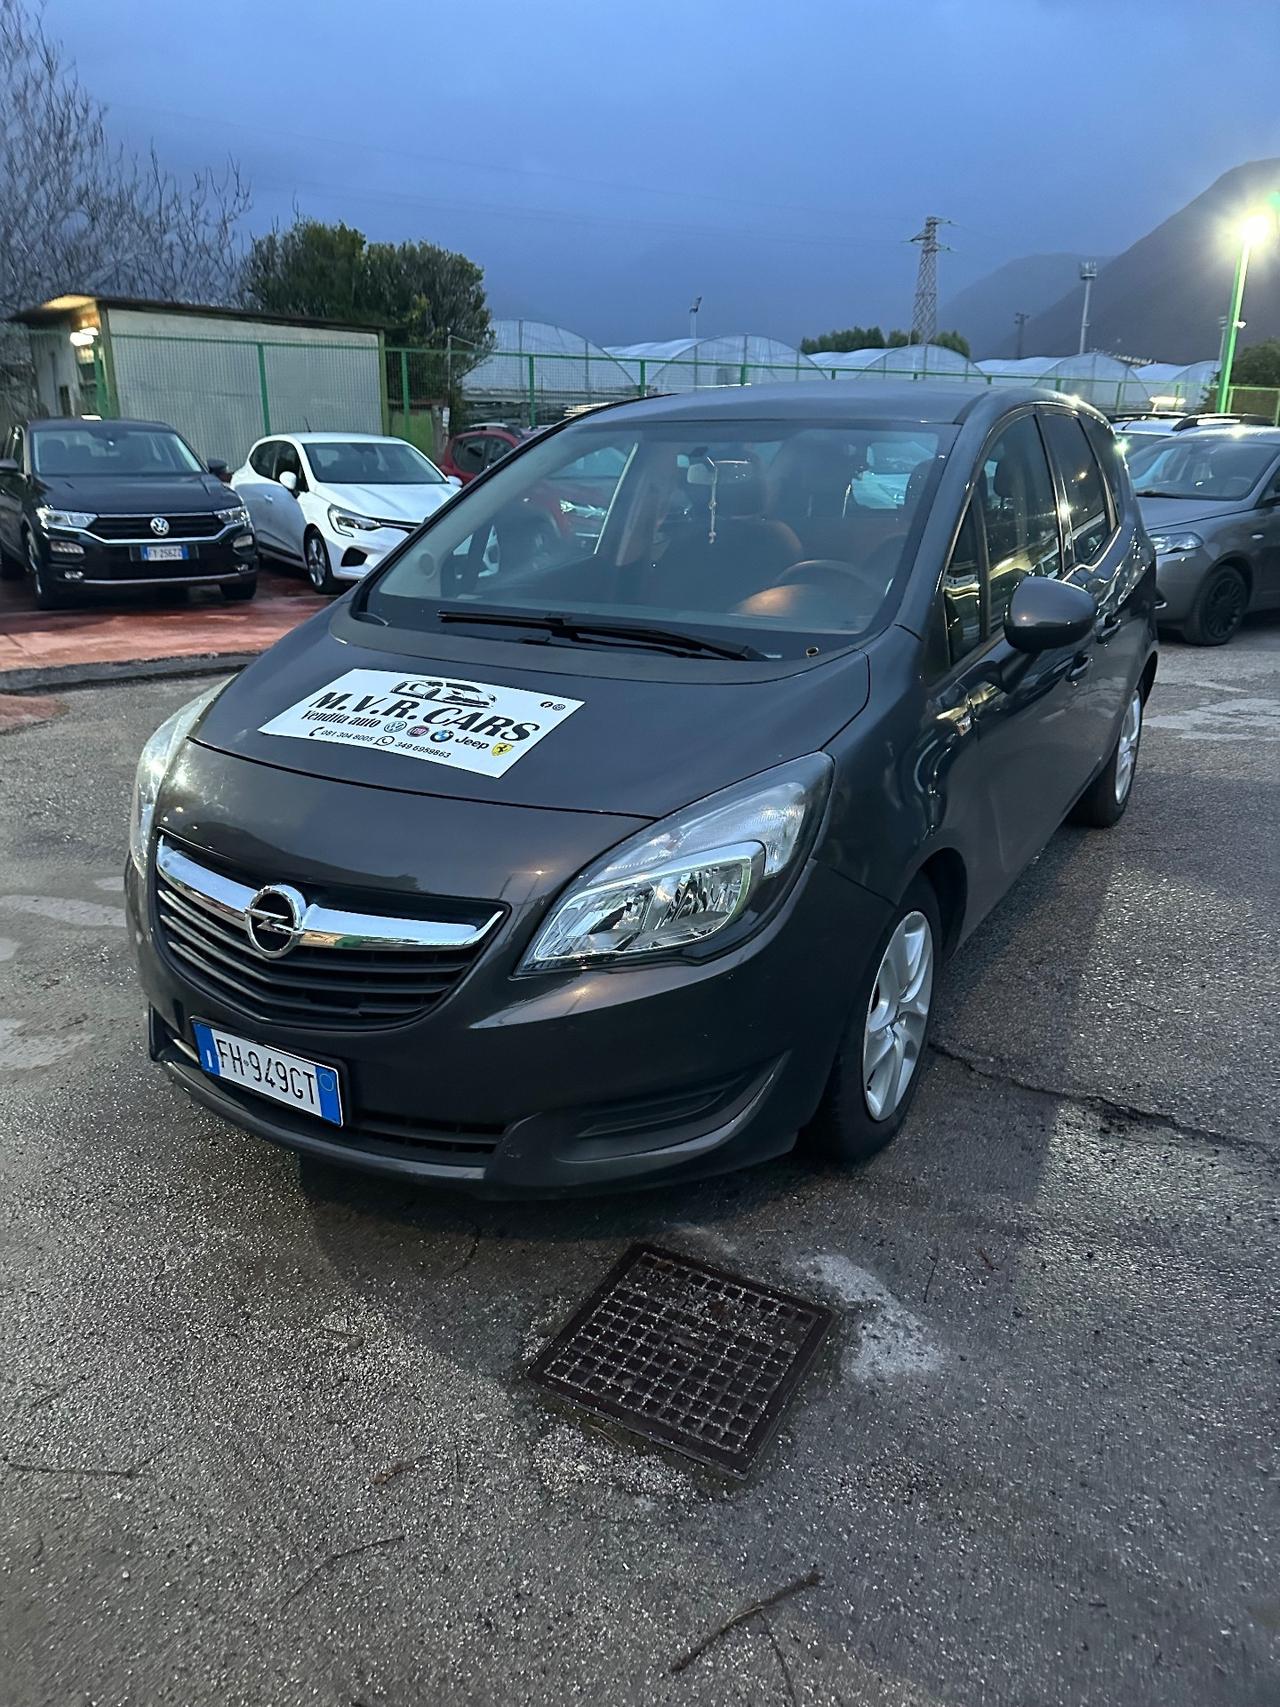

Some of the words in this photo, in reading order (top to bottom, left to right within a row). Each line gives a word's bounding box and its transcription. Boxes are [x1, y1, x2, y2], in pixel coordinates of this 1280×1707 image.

[301, 710, 350, 724] Vendita
[348, 716, 382, 728] auto
[422, 707, 540, 741] CARS
[395, 741, 413, 750] 349
[455, 731, 490, 750] Jeep
